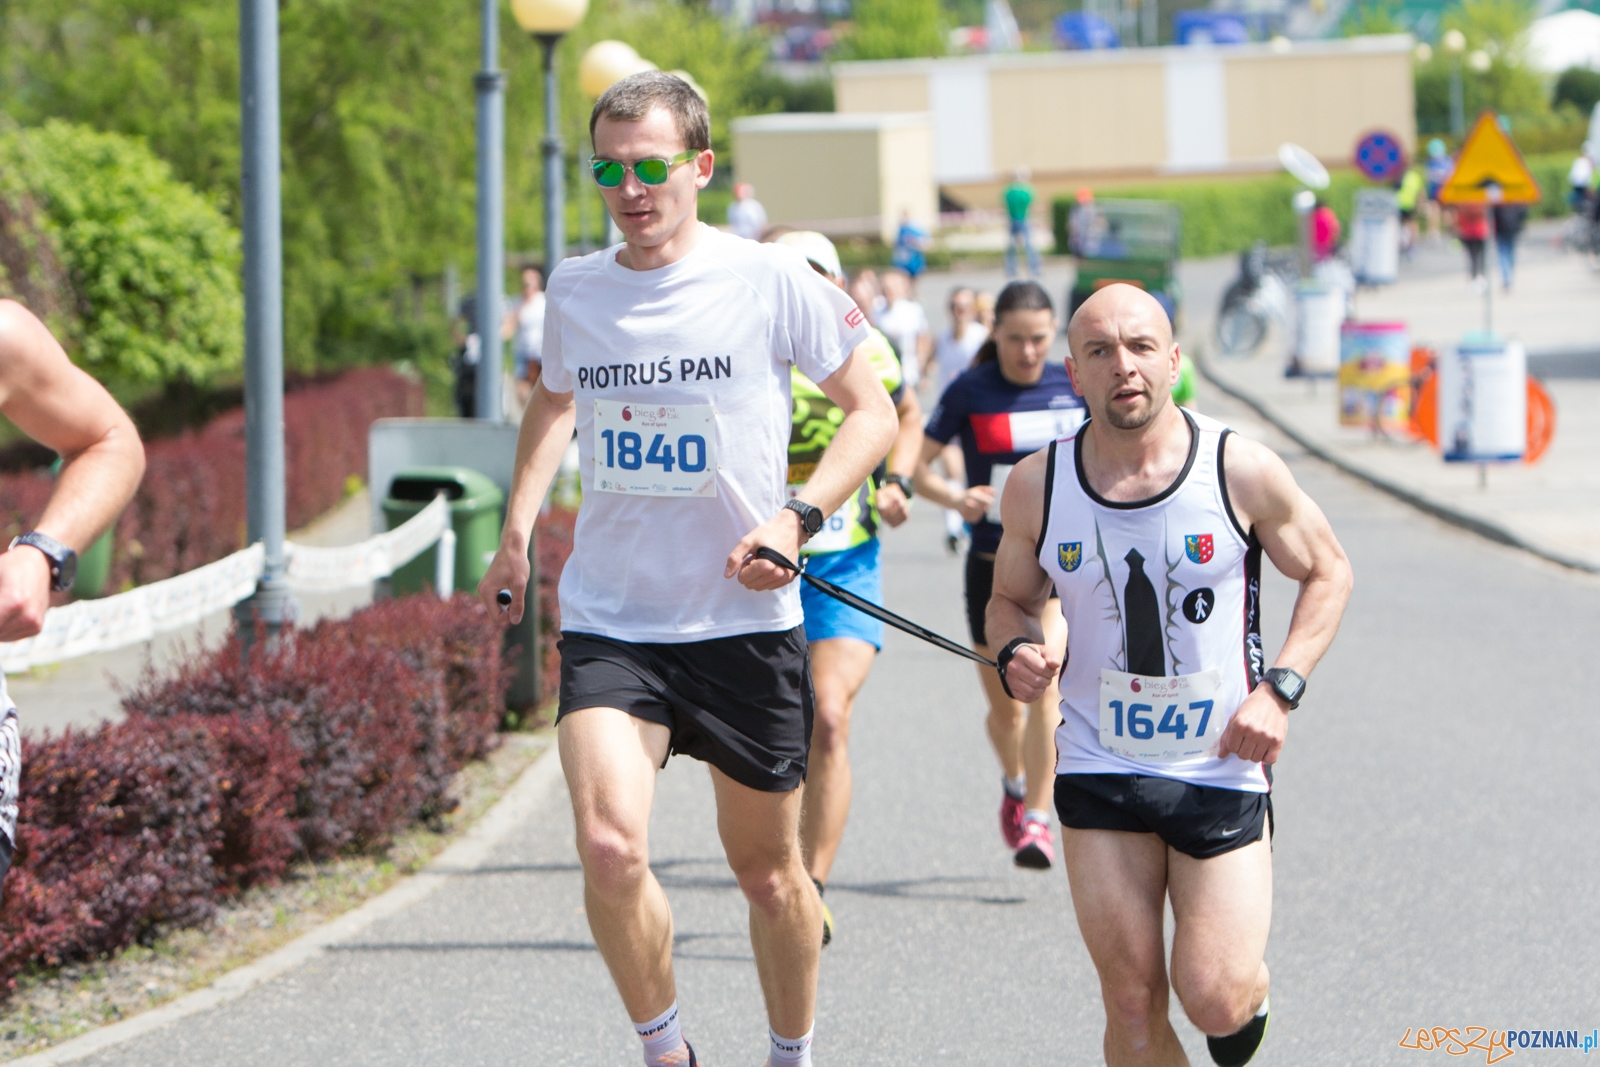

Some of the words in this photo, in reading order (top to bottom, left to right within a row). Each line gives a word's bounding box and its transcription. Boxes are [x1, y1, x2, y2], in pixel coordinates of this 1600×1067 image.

[578, 355, 672, 389] PIOTRUŚ
[680, 355, 731, 381] PAN
[634, 405, 657, 421] bieg
[601, 429, 706, 473] 1840
[1144, 678, 1168, 693] bieg
[1109, 699, 1214, 740] 1647
